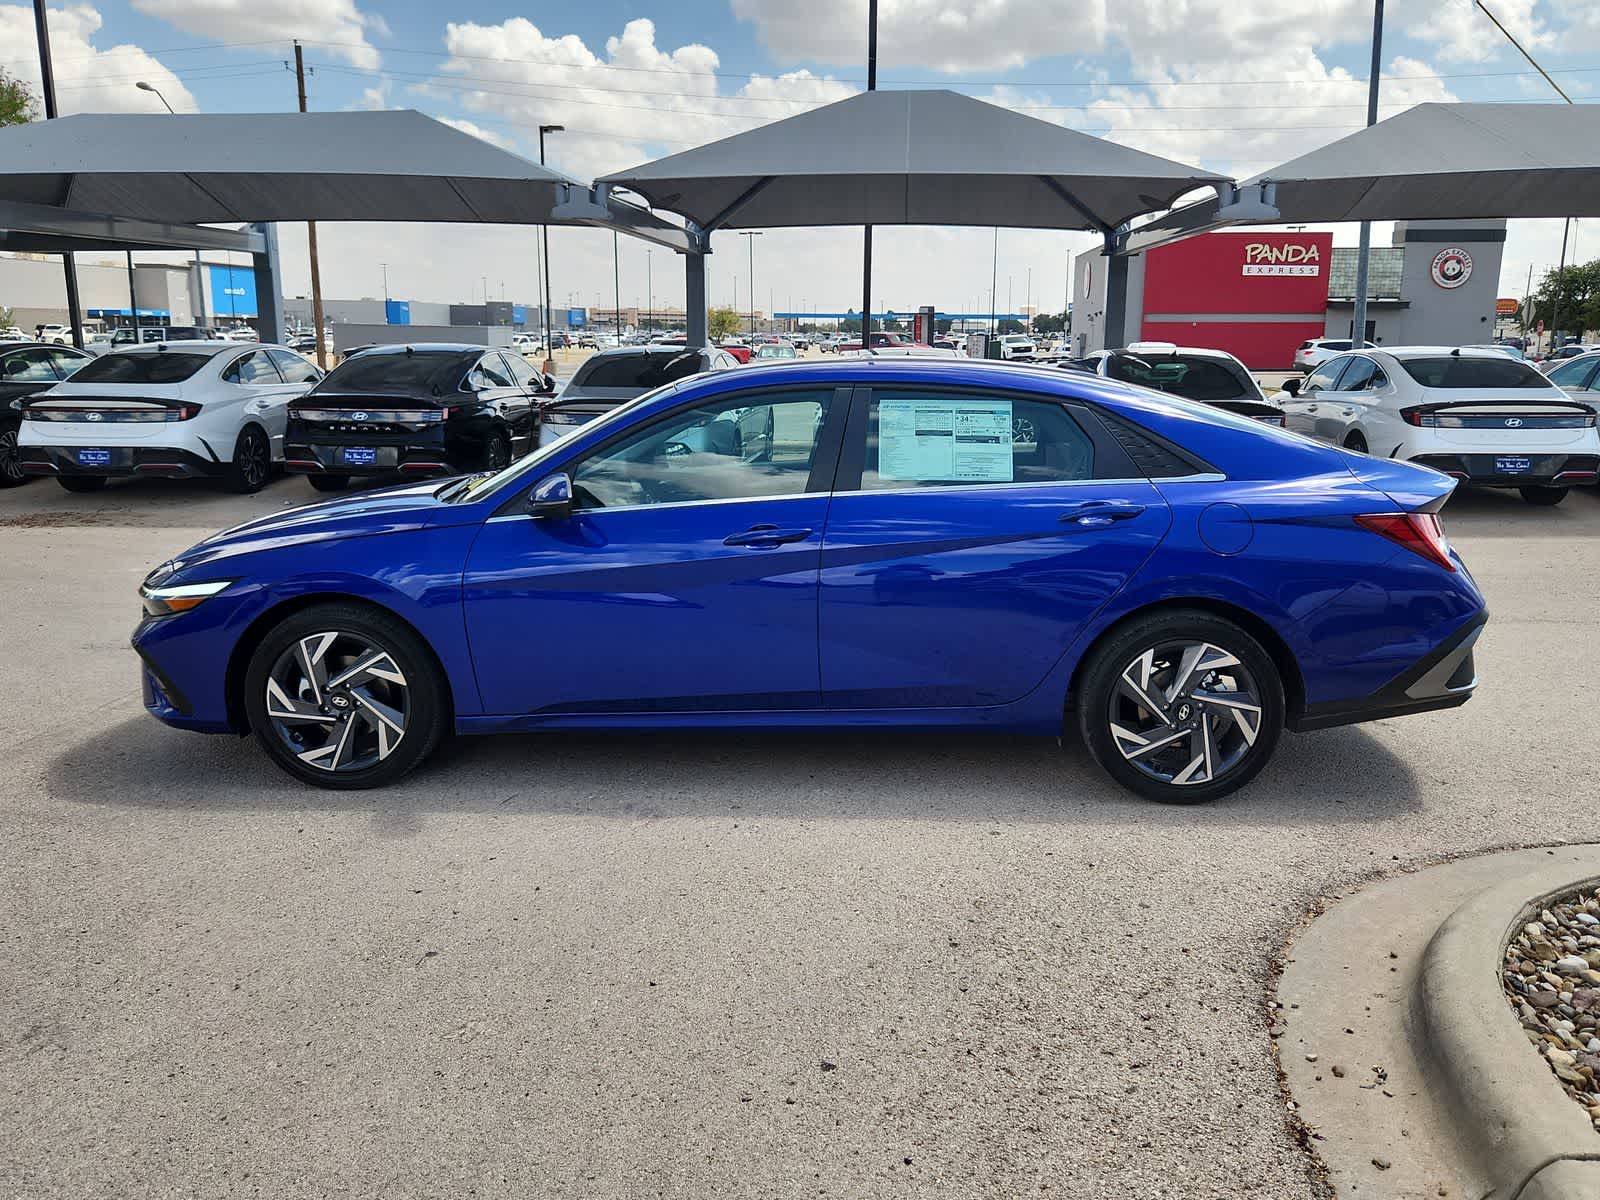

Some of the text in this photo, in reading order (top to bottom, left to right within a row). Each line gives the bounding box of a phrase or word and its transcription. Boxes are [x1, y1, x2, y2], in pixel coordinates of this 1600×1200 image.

[1245, 243, 1320, 264] PANDA
[1433, 250, 1450, 269] PANDA
[1247, 266, 1316, 274] EXPRESS
[960, 415, 969, 423] 34
